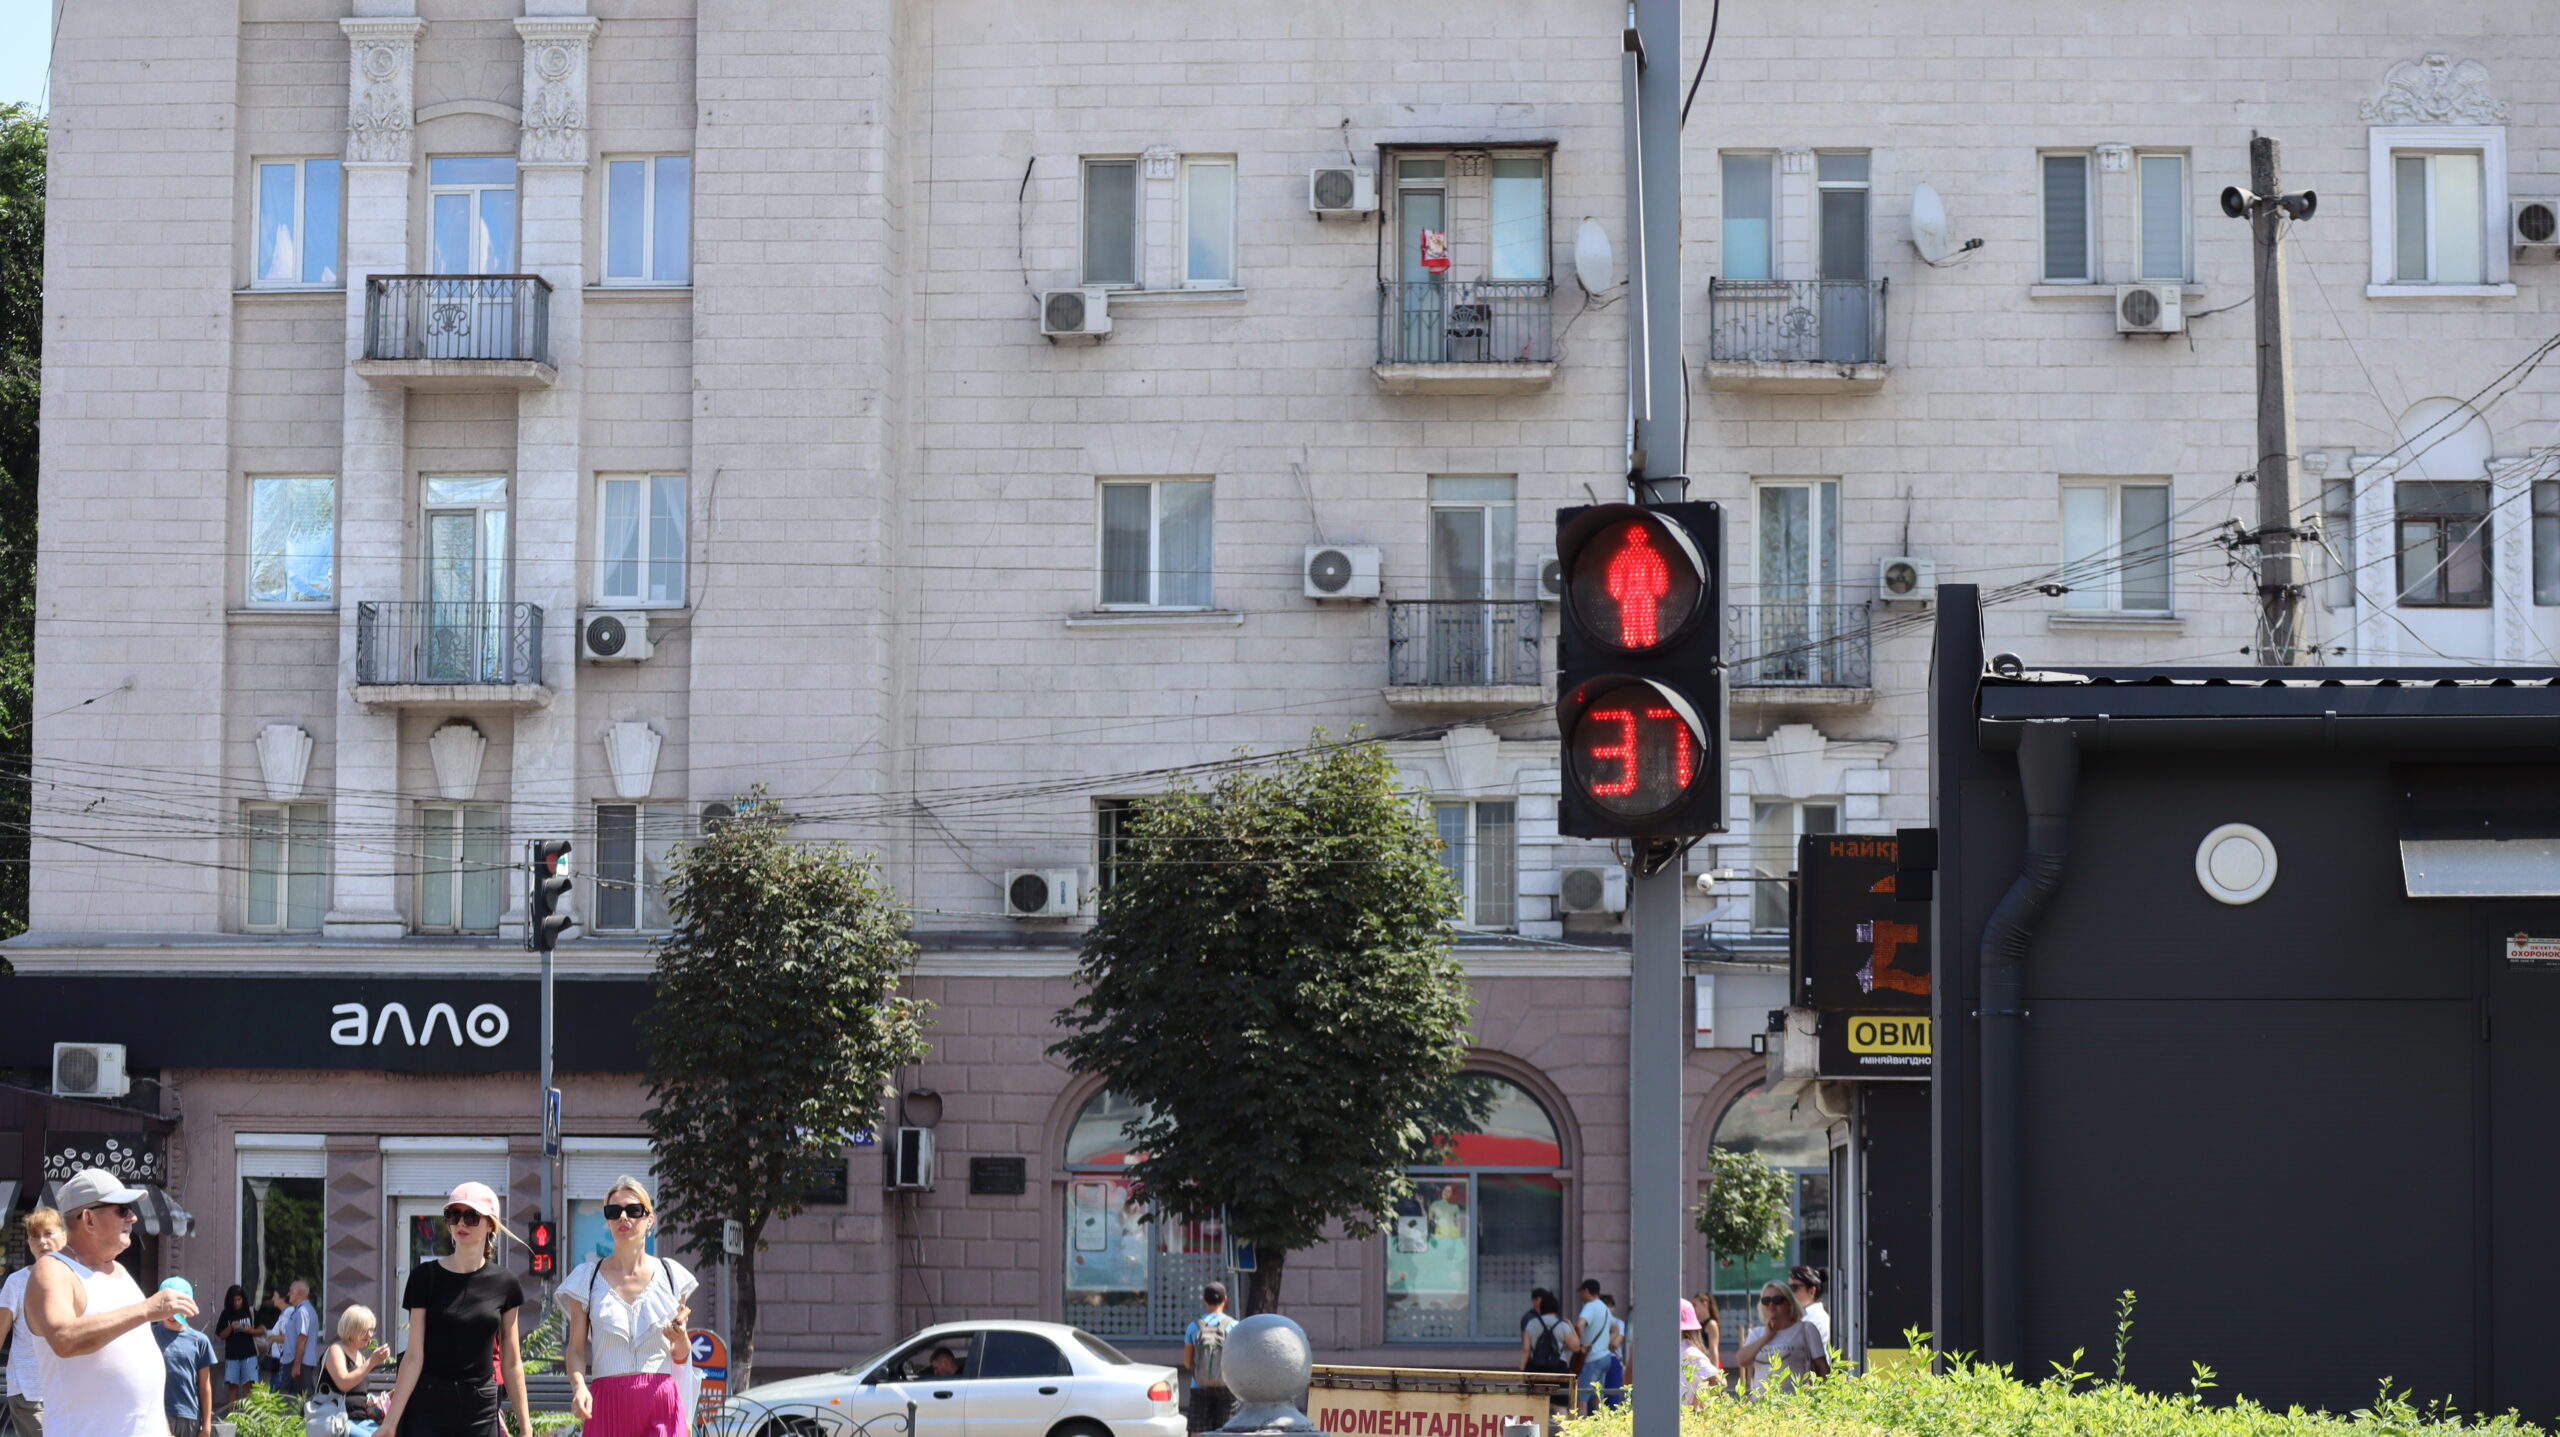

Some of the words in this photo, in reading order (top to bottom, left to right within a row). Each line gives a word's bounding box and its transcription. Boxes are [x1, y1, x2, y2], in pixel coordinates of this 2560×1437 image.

[1592, 709, 1693, 796] 37
[533, 1253, 552, 1271] 37
[1320, 1408, 1534, 1437] МОМЕНТАЛЬН
